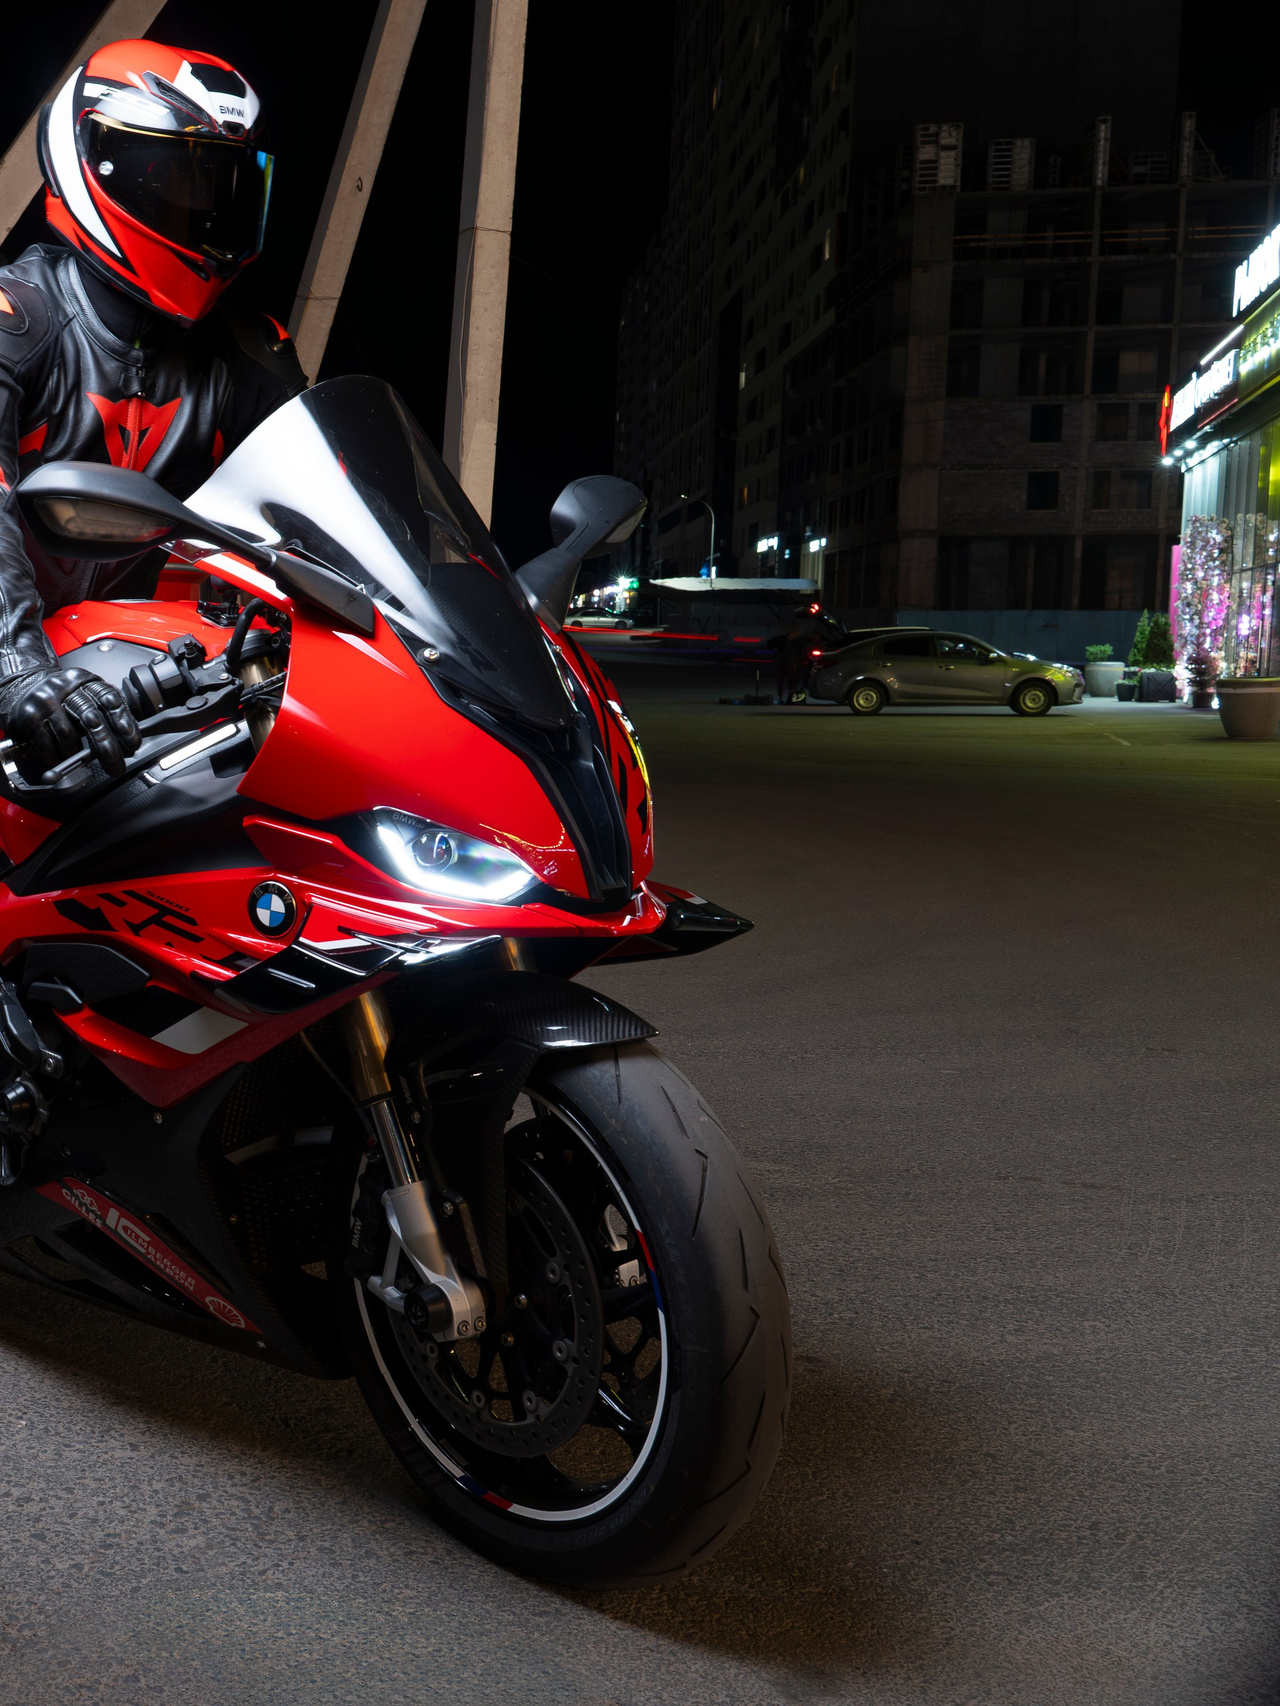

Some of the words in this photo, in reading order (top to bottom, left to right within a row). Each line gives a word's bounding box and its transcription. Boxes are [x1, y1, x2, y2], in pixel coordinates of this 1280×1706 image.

[218, 104, 245, 119] BMW
[144, 890, 190, 912] S1000
[253, 883, 293, 905] BMW
[62, 1188, 103, 1228] GILLES
[352, 1217, 362, 1249] BMW
